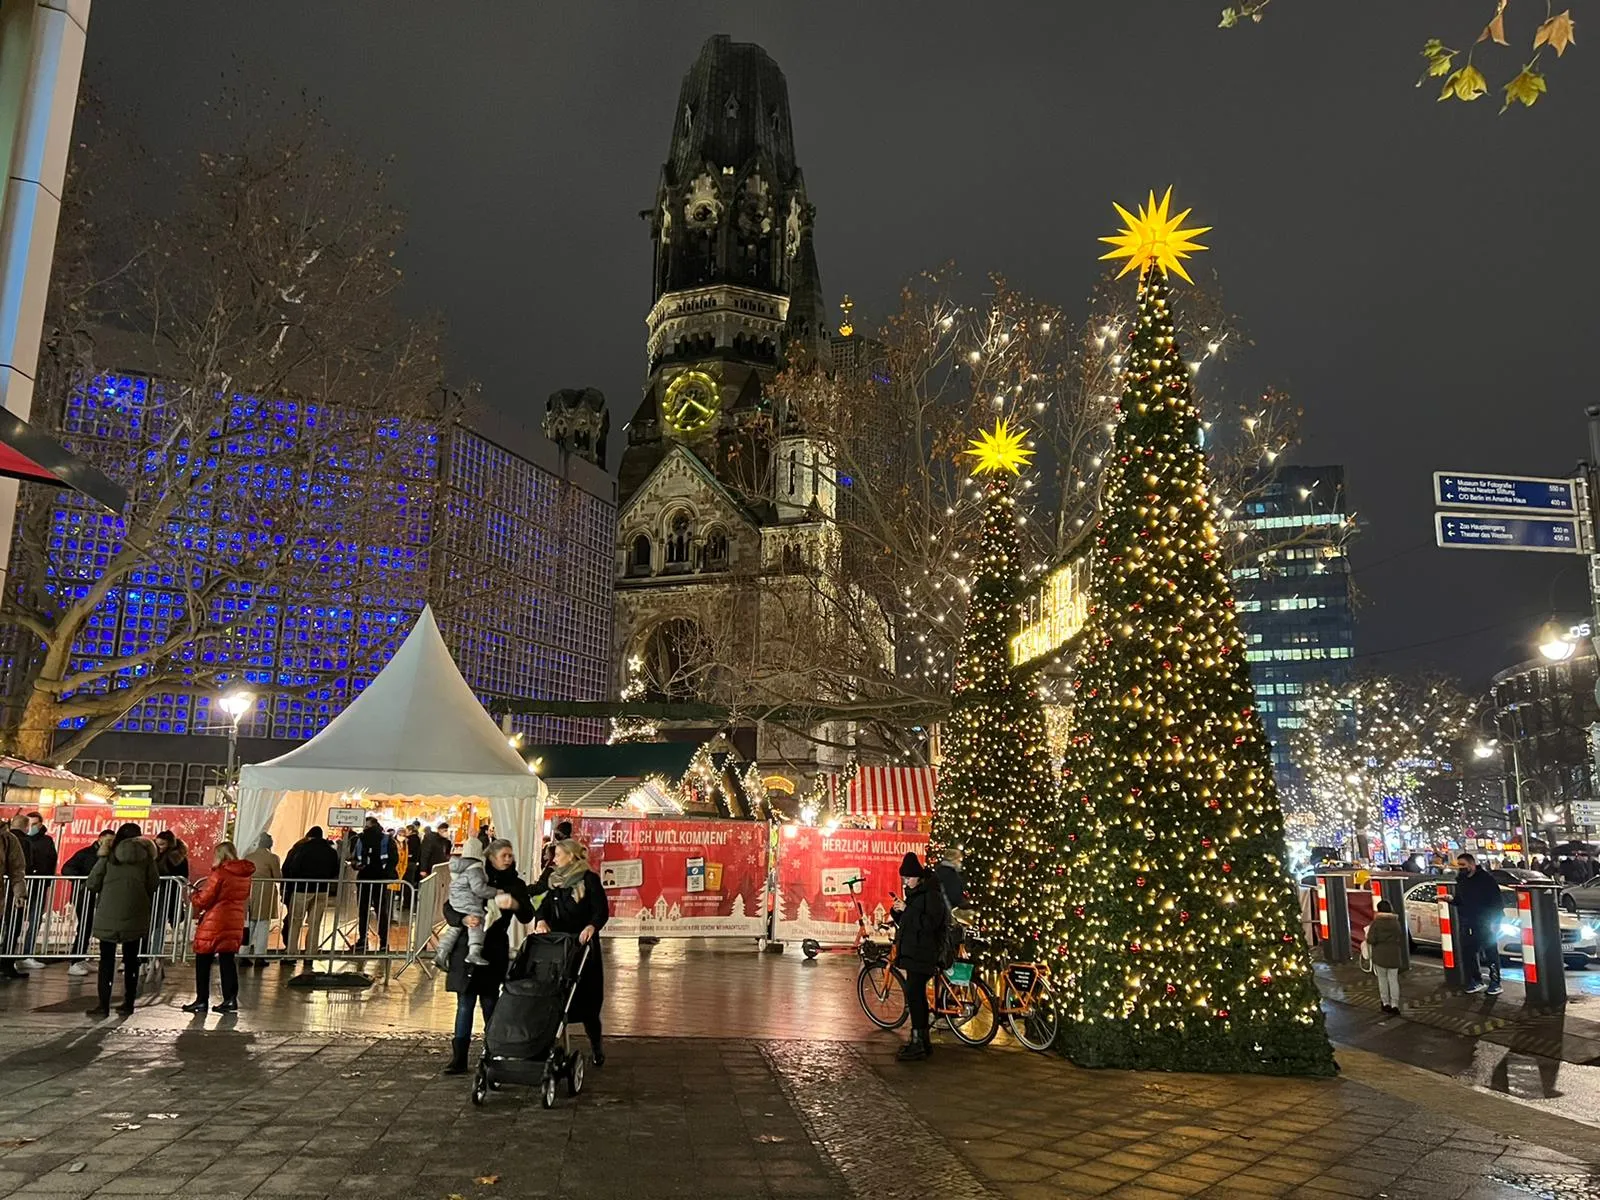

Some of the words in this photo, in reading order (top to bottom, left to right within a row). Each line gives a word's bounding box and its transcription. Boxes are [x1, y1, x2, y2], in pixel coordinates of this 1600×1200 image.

[602, 830, 652, 844] HERZLICH
[655, 831, 727, 845] WILLKOMMEN!
[822, 838, 868, 852] HERZLICH
